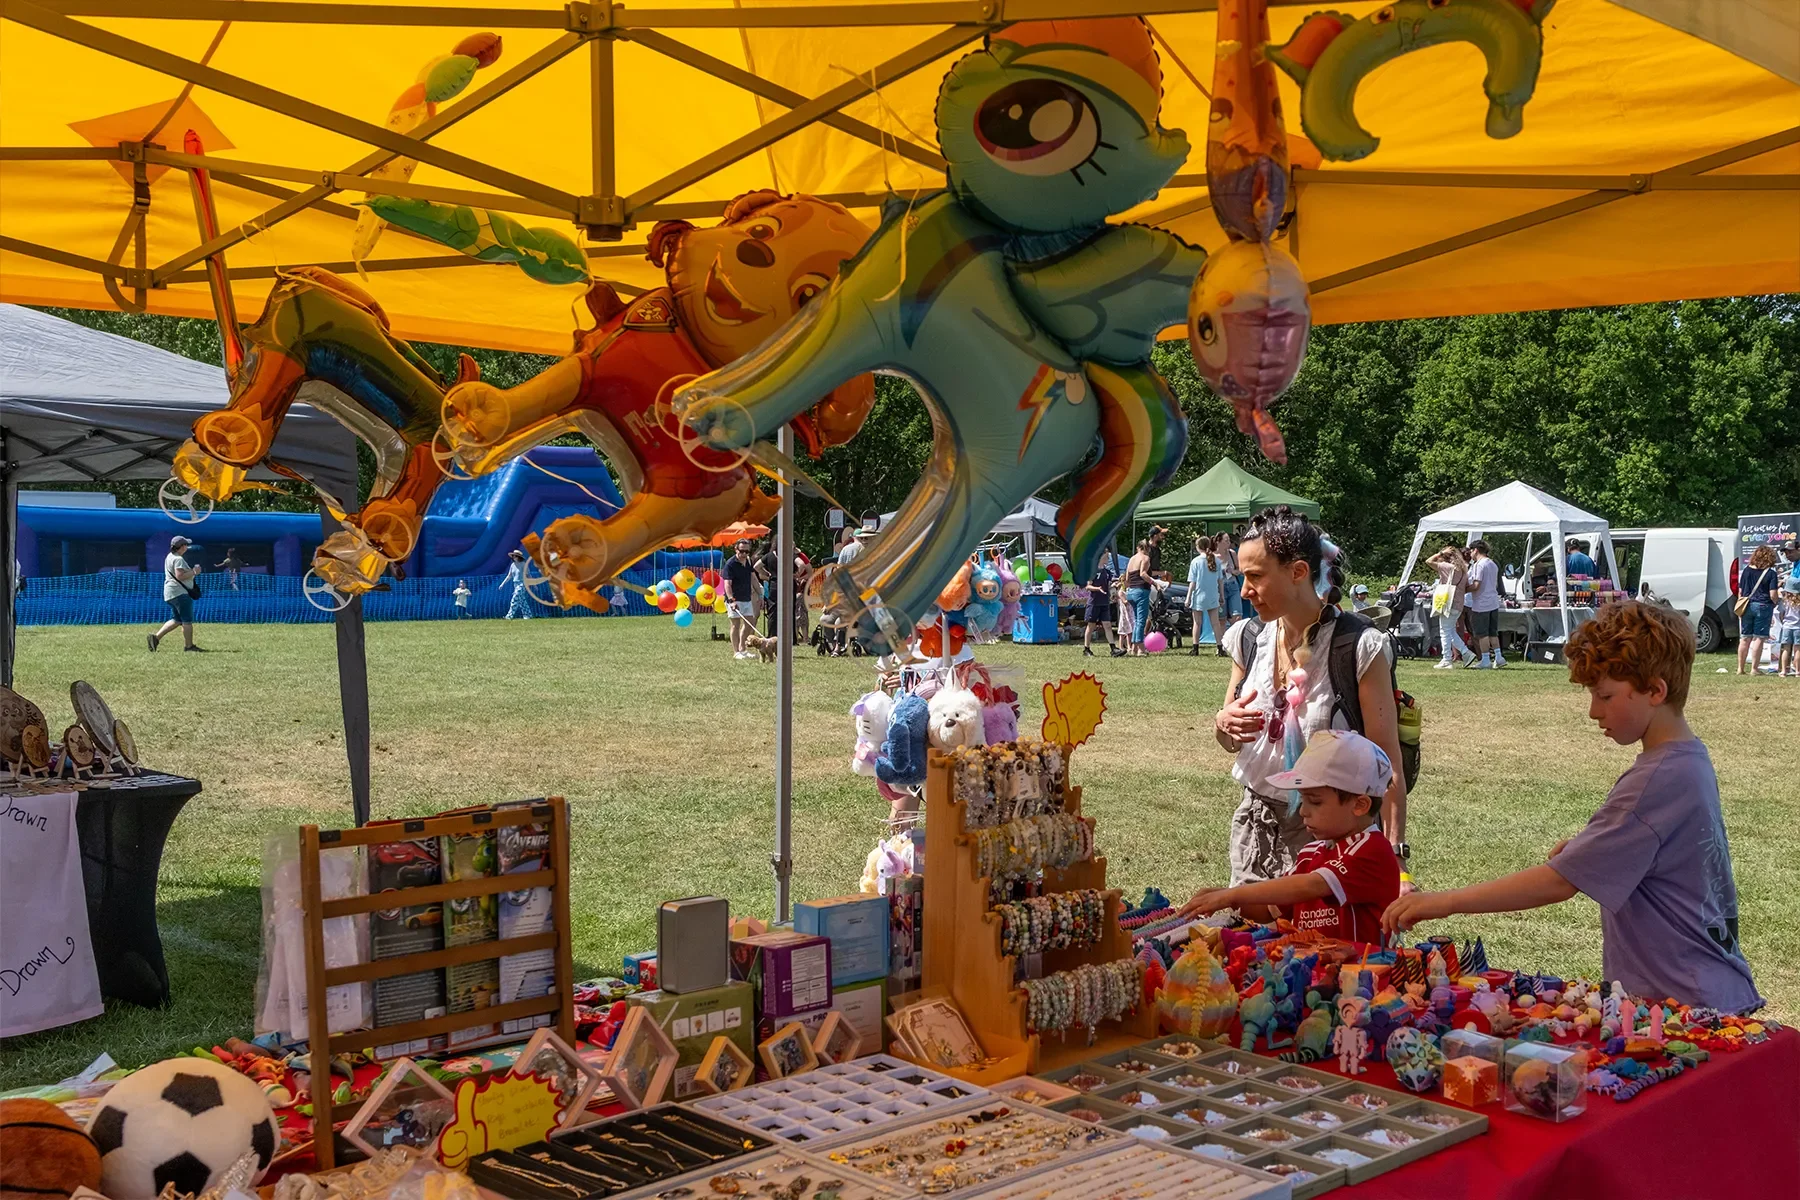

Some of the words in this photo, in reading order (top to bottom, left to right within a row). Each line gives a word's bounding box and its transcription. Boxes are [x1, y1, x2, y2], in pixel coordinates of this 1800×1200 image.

[1742, 525, 1777, 533] Activities
[1779, 522, 1790, 534] for
[1742, 532, 1797, 543] everyone
